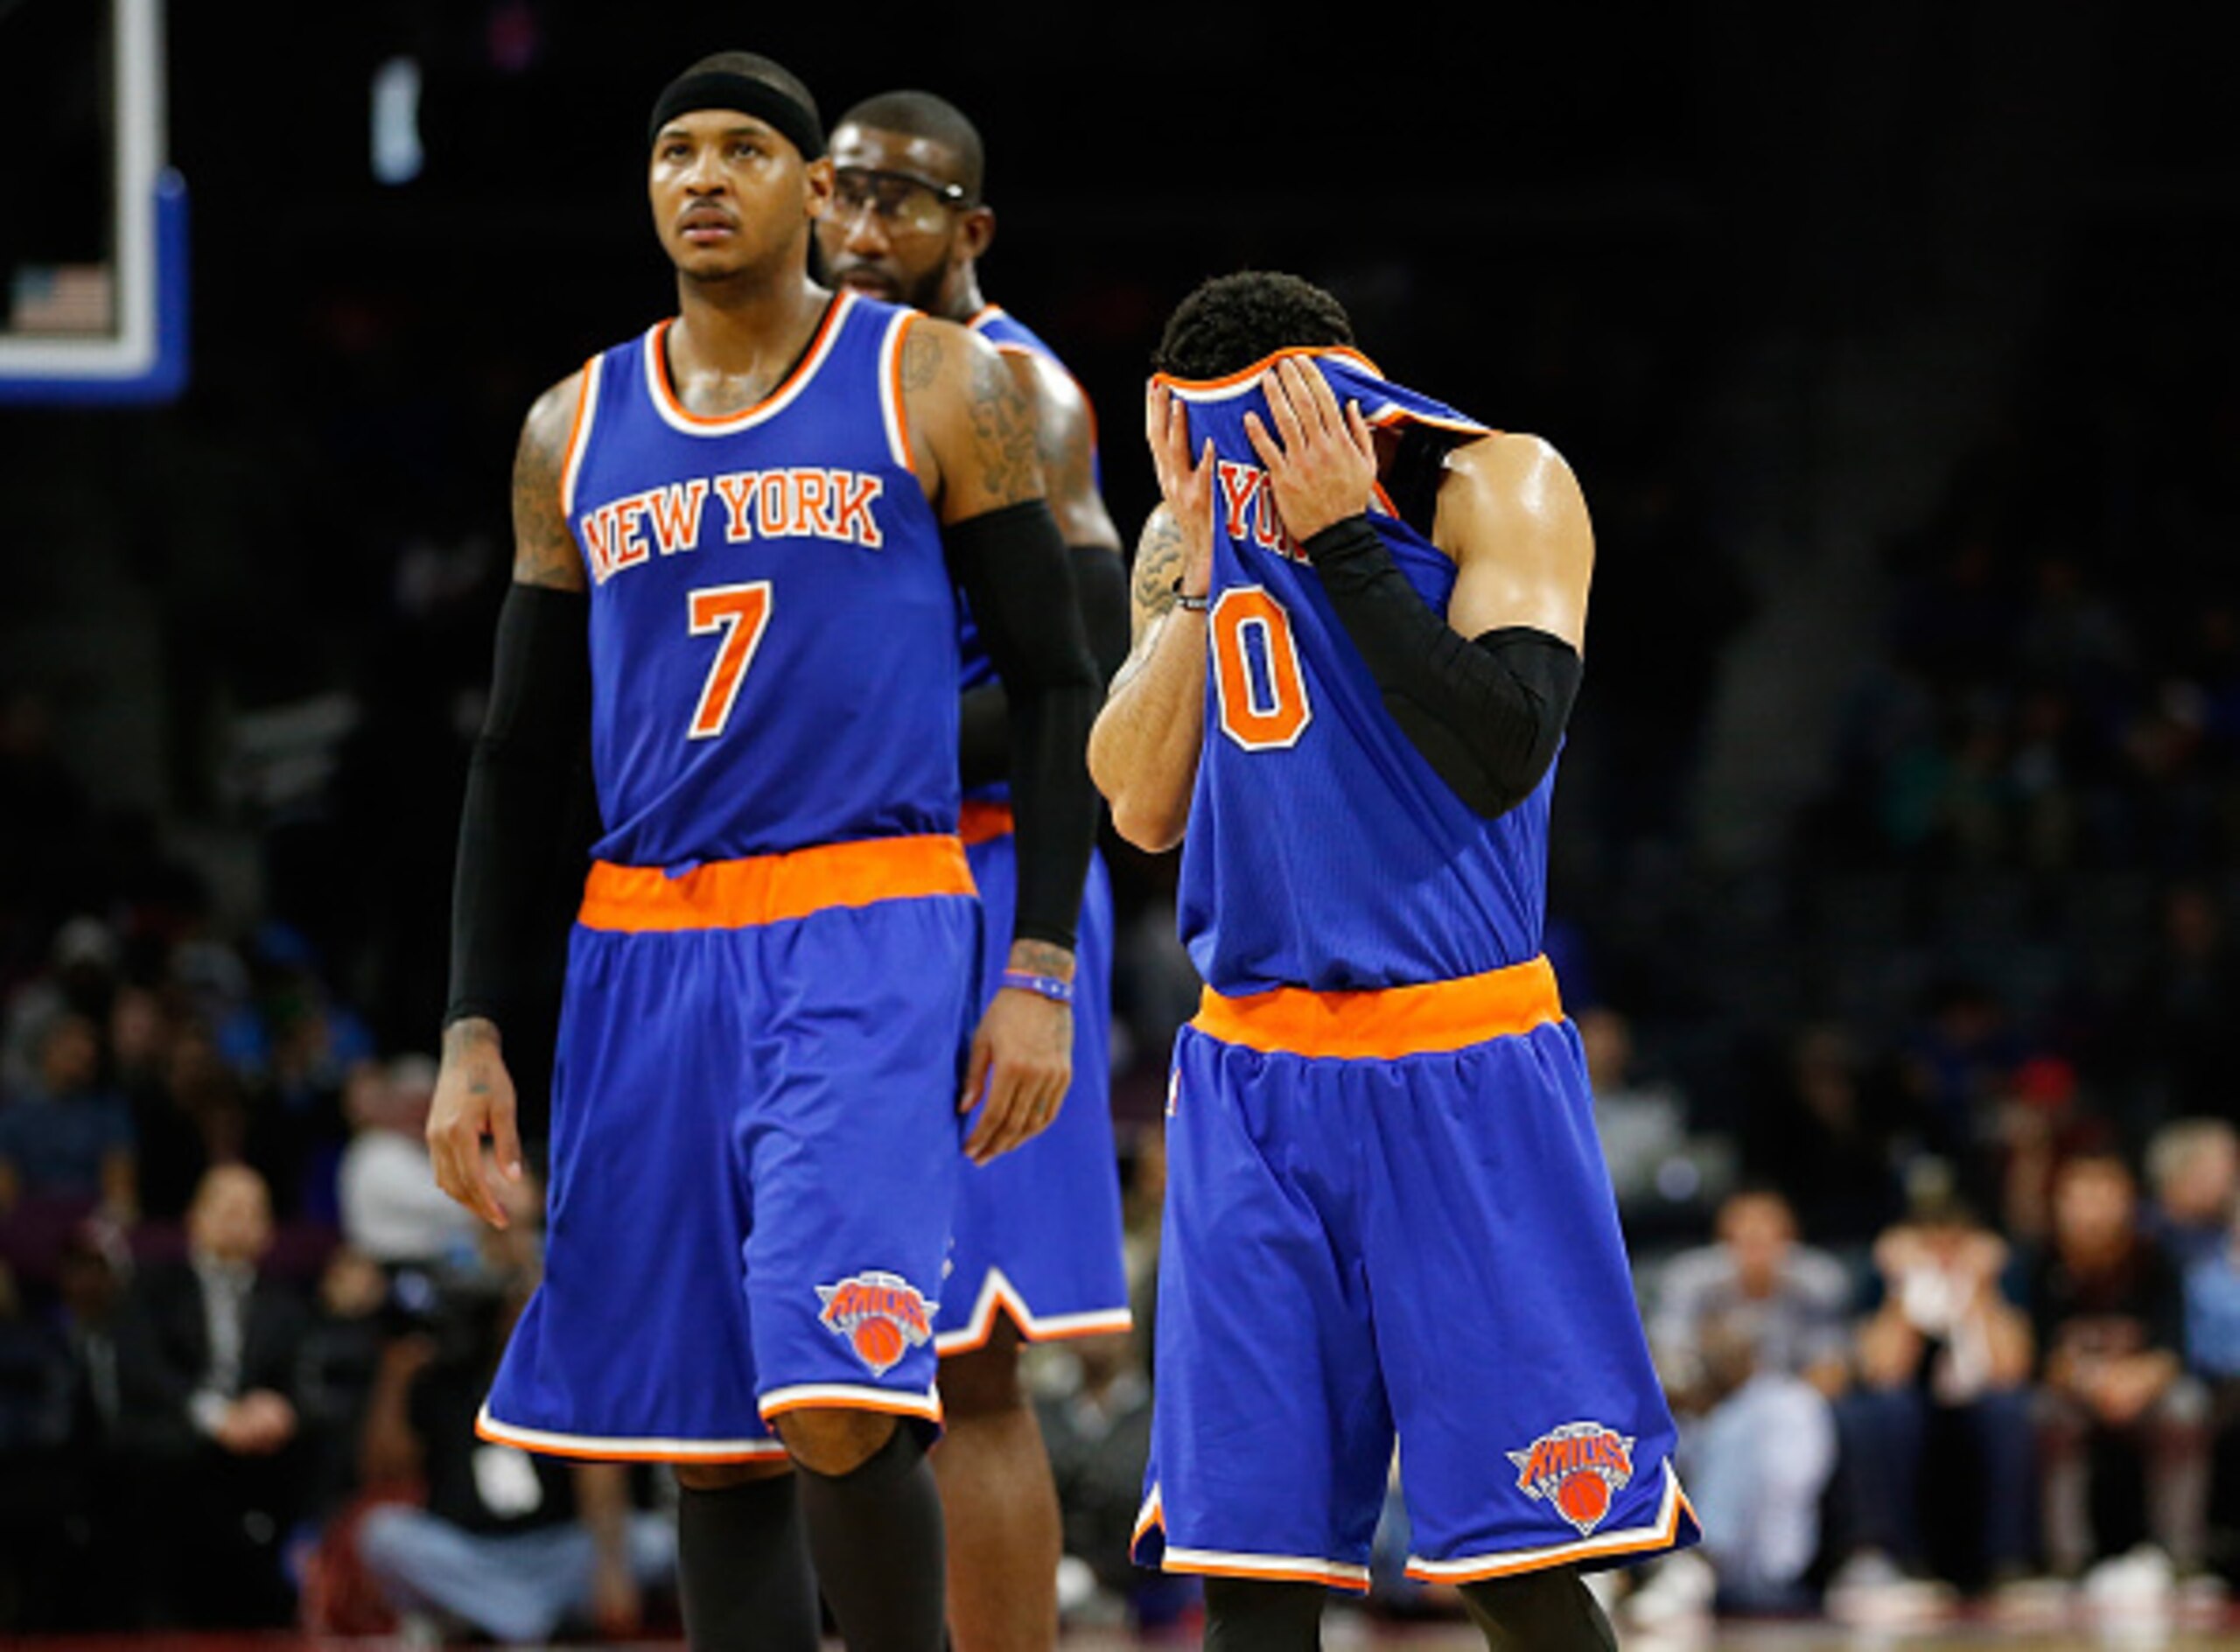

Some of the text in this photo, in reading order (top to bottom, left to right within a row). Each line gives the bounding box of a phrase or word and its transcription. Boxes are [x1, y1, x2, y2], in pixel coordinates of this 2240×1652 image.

[580, 467, 883, 585] NEW YORK
[687, 579, 771, 740] 7
[1209, 584, 1312, 752] 0
[1520, 1432, 1631, 1488] KNICKS
